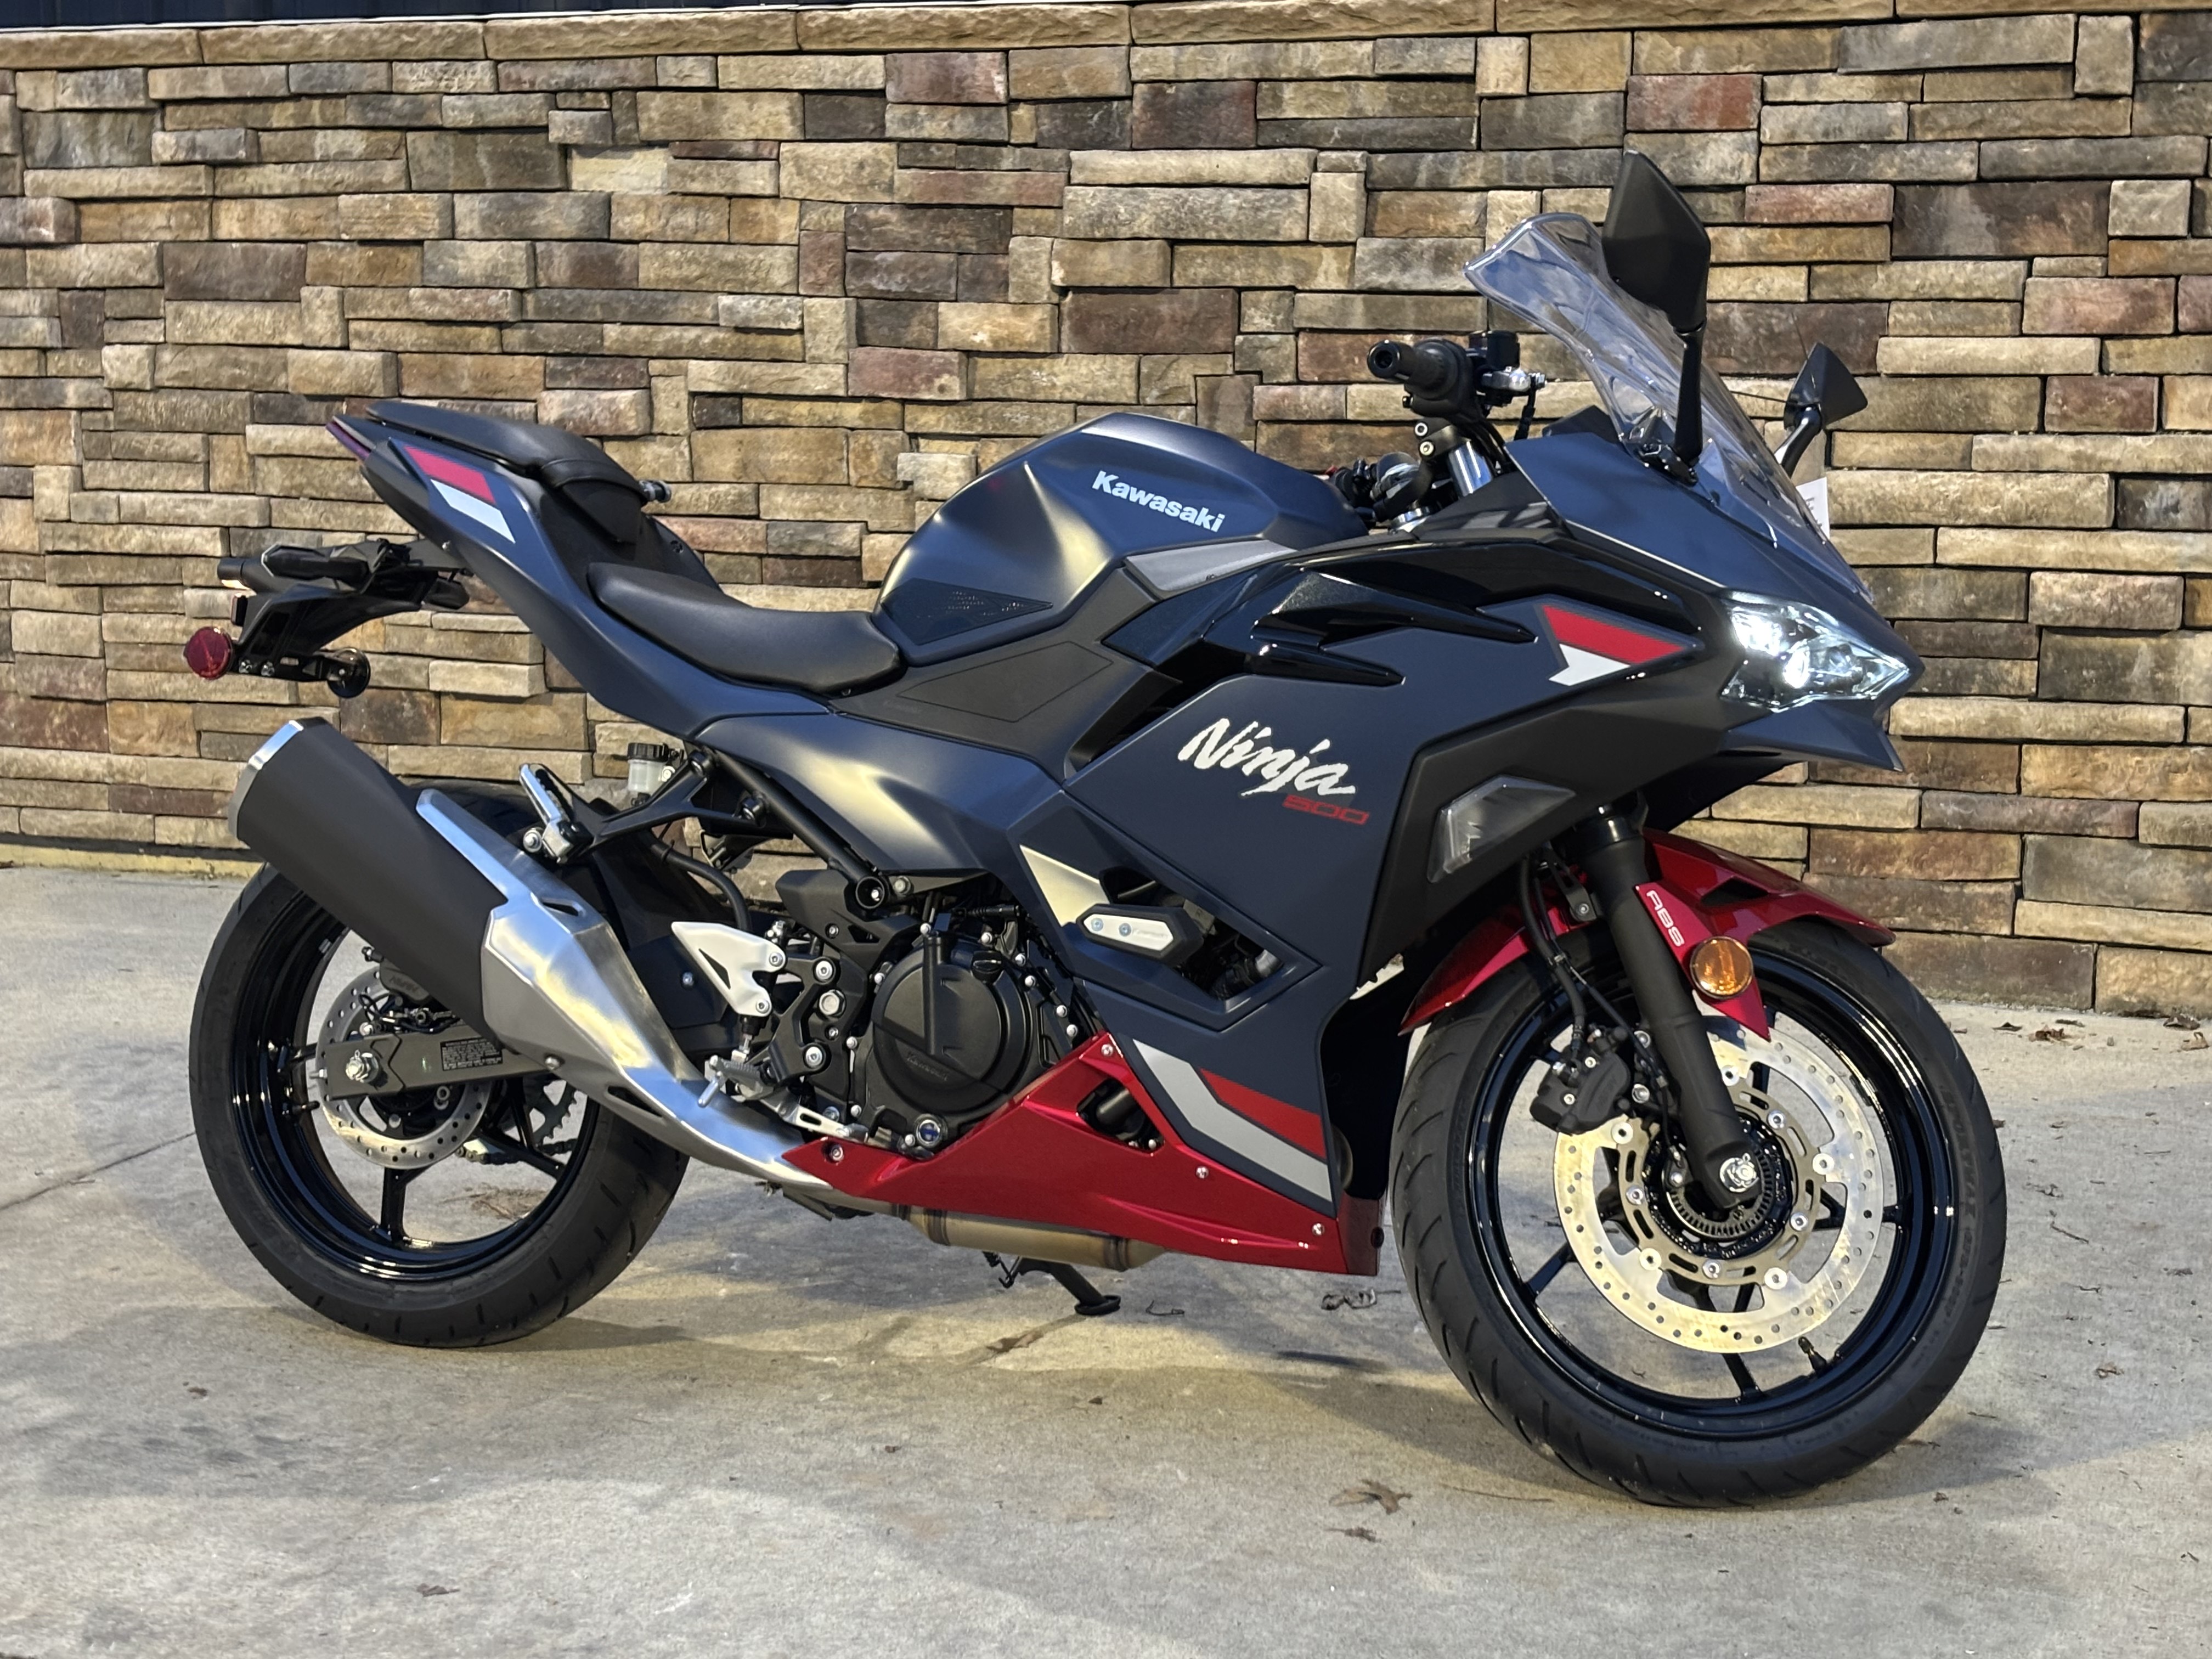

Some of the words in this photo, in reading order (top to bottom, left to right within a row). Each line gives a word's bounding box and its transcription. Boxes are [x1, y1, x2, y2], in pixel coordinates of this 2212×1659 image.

[1092, 470, 1226, 533] Kawasaki
[1177, 718, 1356, 796] Ninja
[1282, 794, 1369, 825] 500
[1646, 890, 1685, 947] ABS
